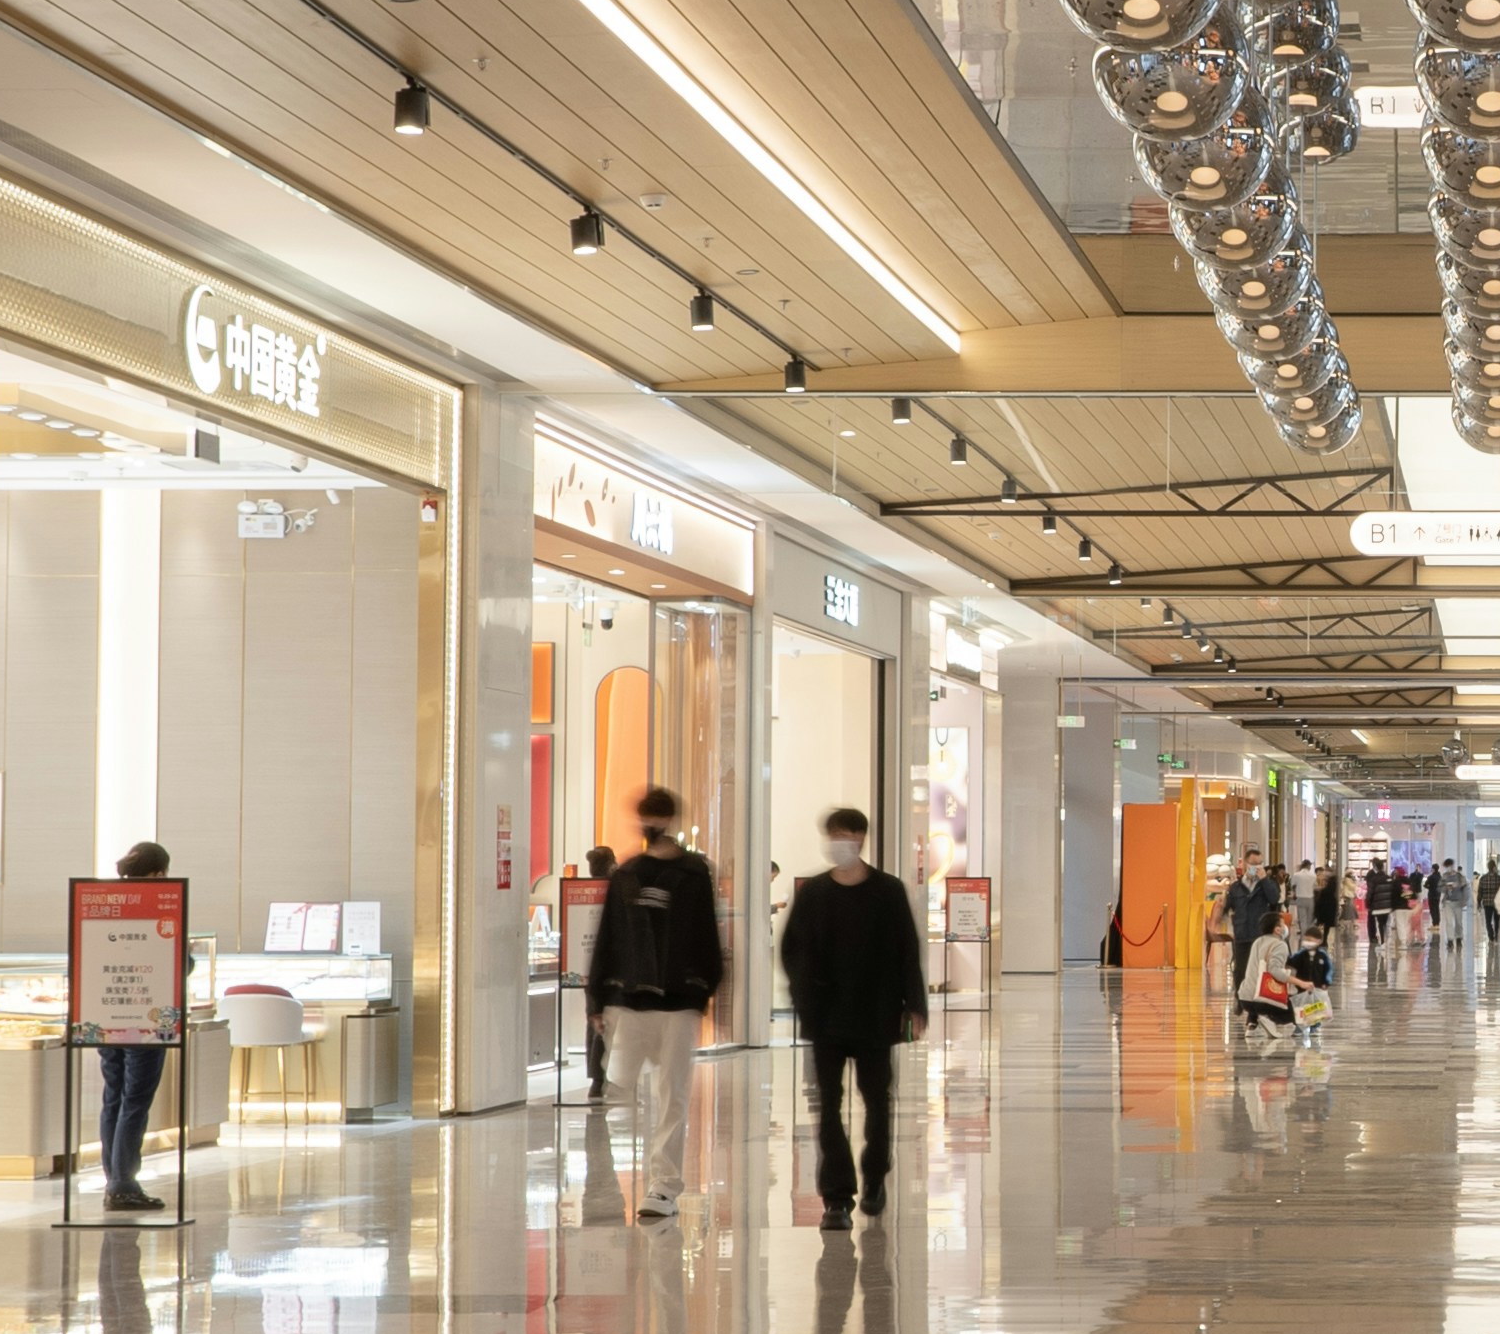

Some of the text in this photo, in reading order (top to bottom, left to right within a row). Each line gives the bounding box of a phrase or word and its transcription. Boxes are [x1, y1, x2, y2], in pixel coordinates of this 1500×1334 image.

[225, 315, 323, 417] 中国黄金
[1370, 524, 1397, 544] B1
[1435, 536, 1455, 544] Gate
[81, 893, 142, 905] BRAND NEW DAY
[118, 933, 148, 942] 中国黄金
